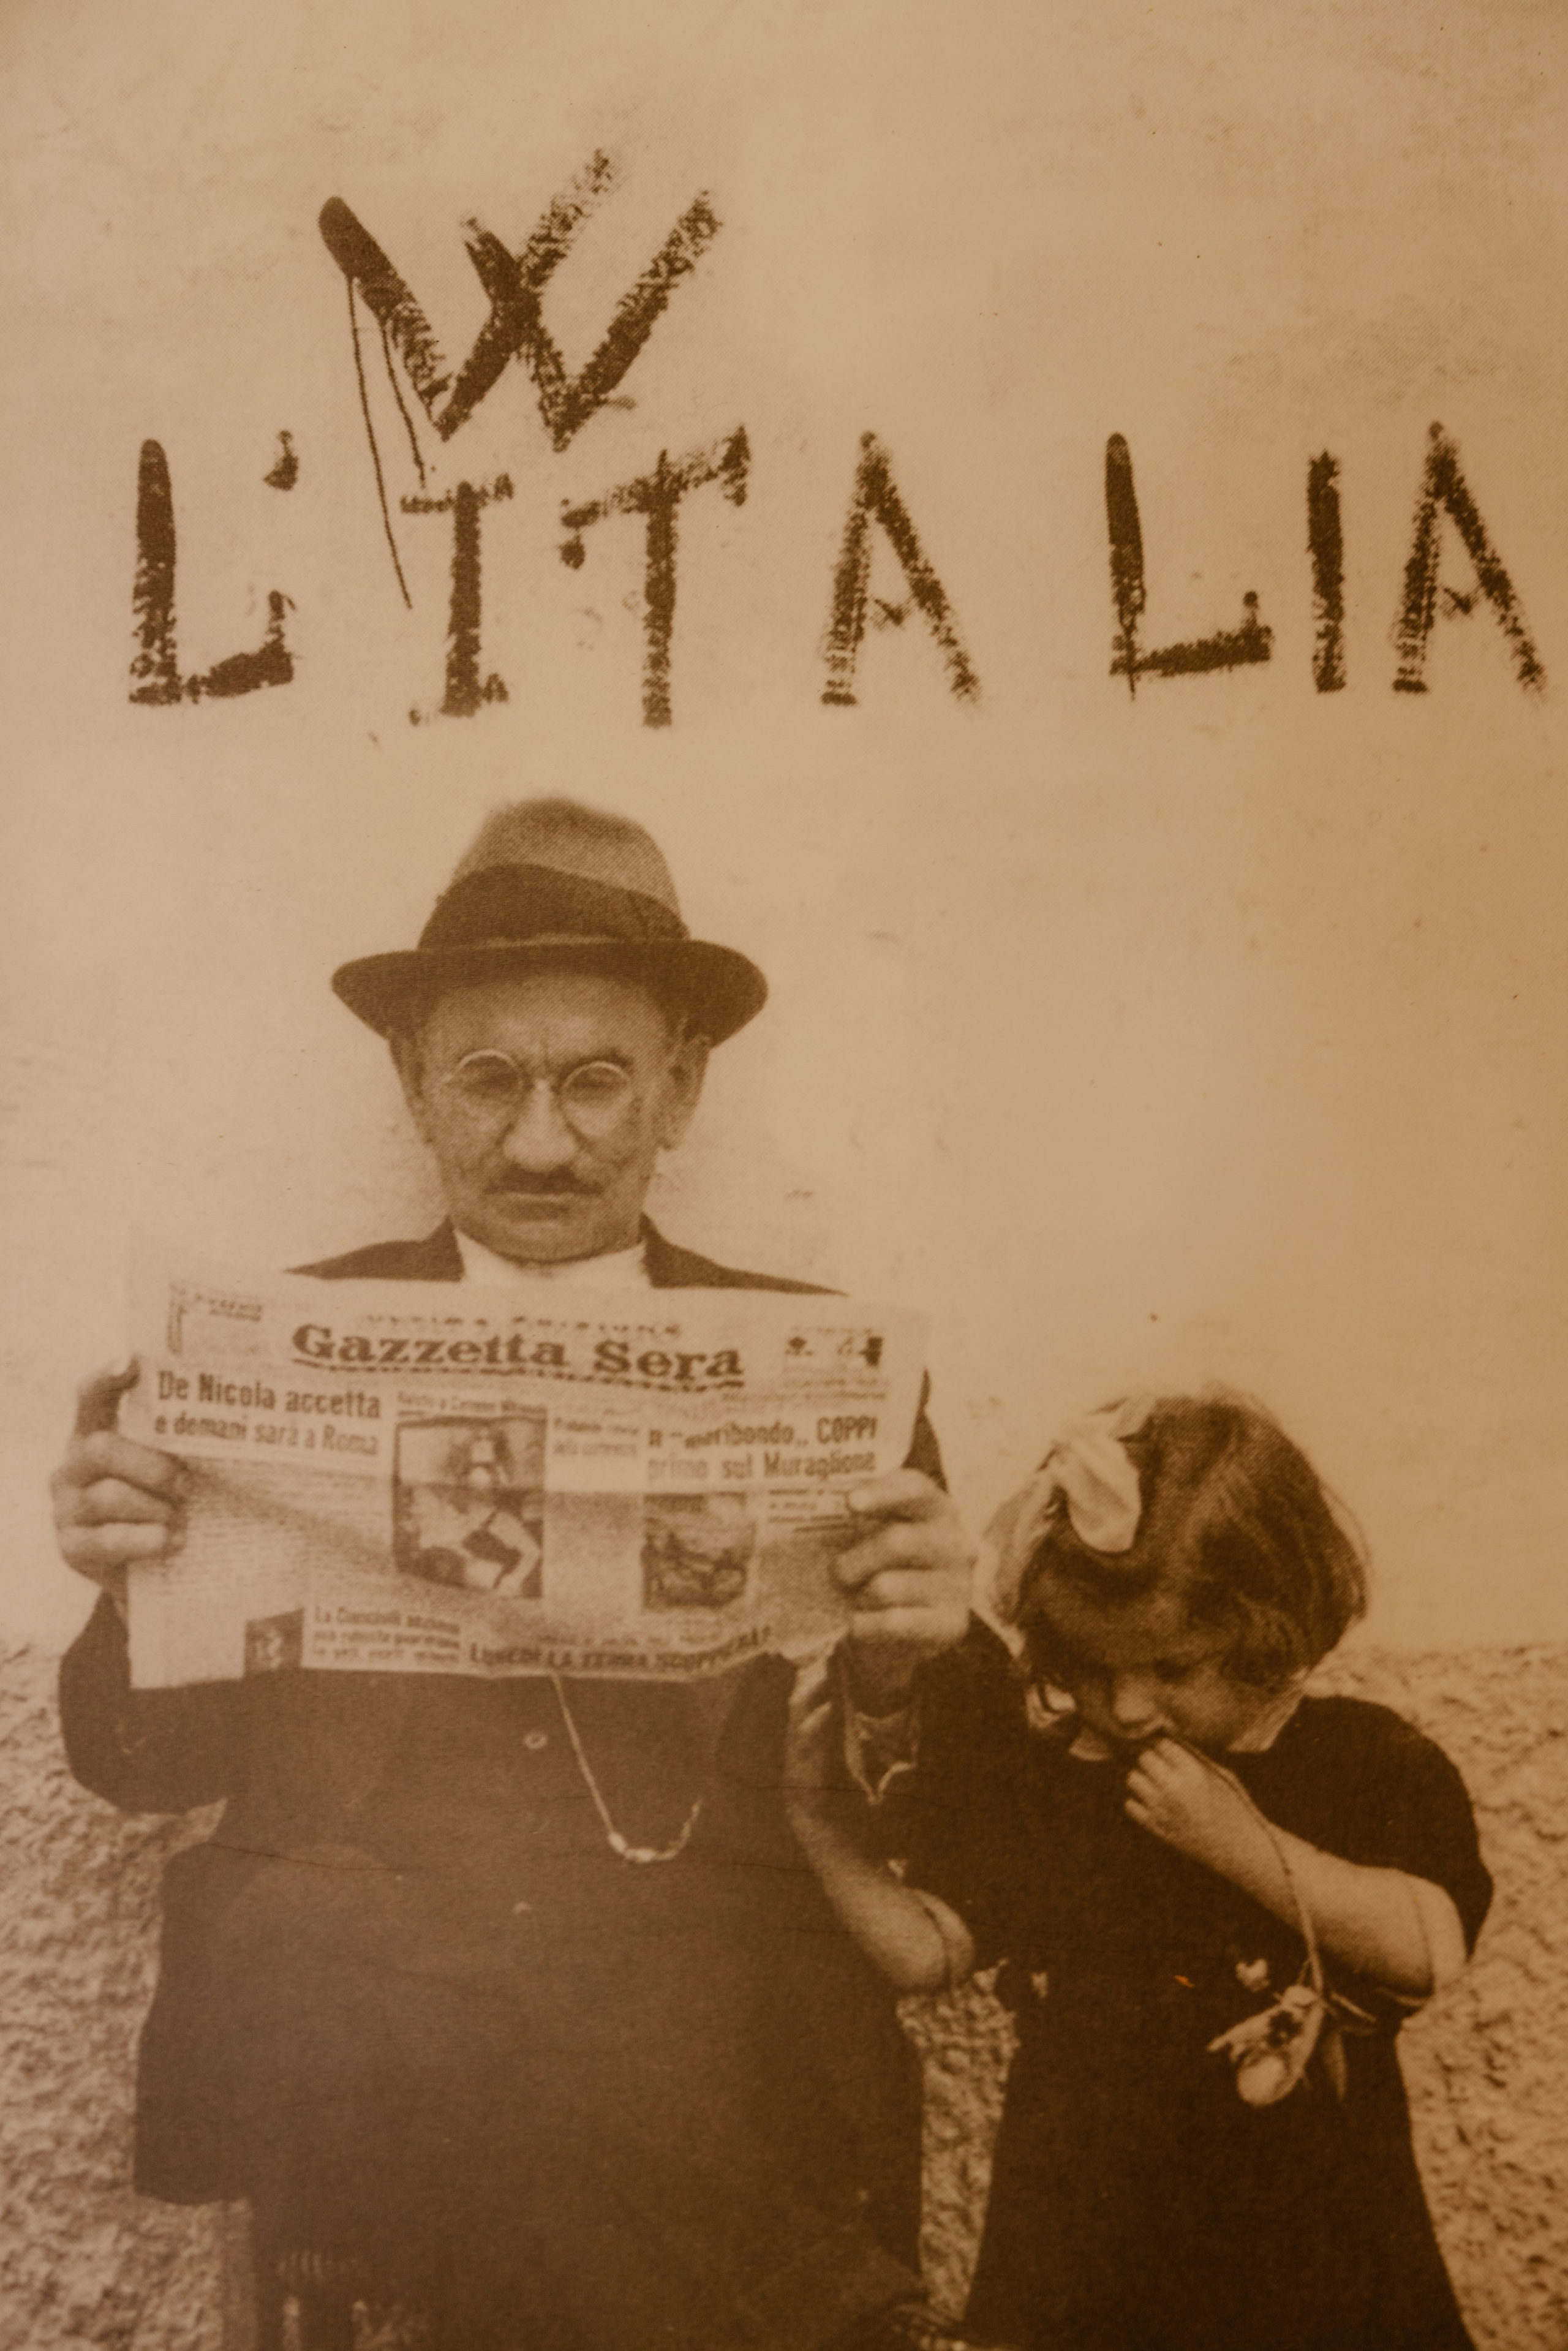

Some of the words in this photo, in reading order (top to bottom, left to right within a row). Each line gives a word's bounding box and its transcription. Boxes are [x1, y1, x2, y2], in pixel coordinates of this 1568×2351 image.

[318, 147, 723, 452] W
[292, 1323, 569, 1367] Gazzetta
[593, 1340, 744, 1381] Sera
[157, 1370, 189, 1401] De
[198, 1372, 276, 1410] Nicola
[285, 1389, 382, 1420] accetta
[816, 1414, 877, 1444] COPPI
